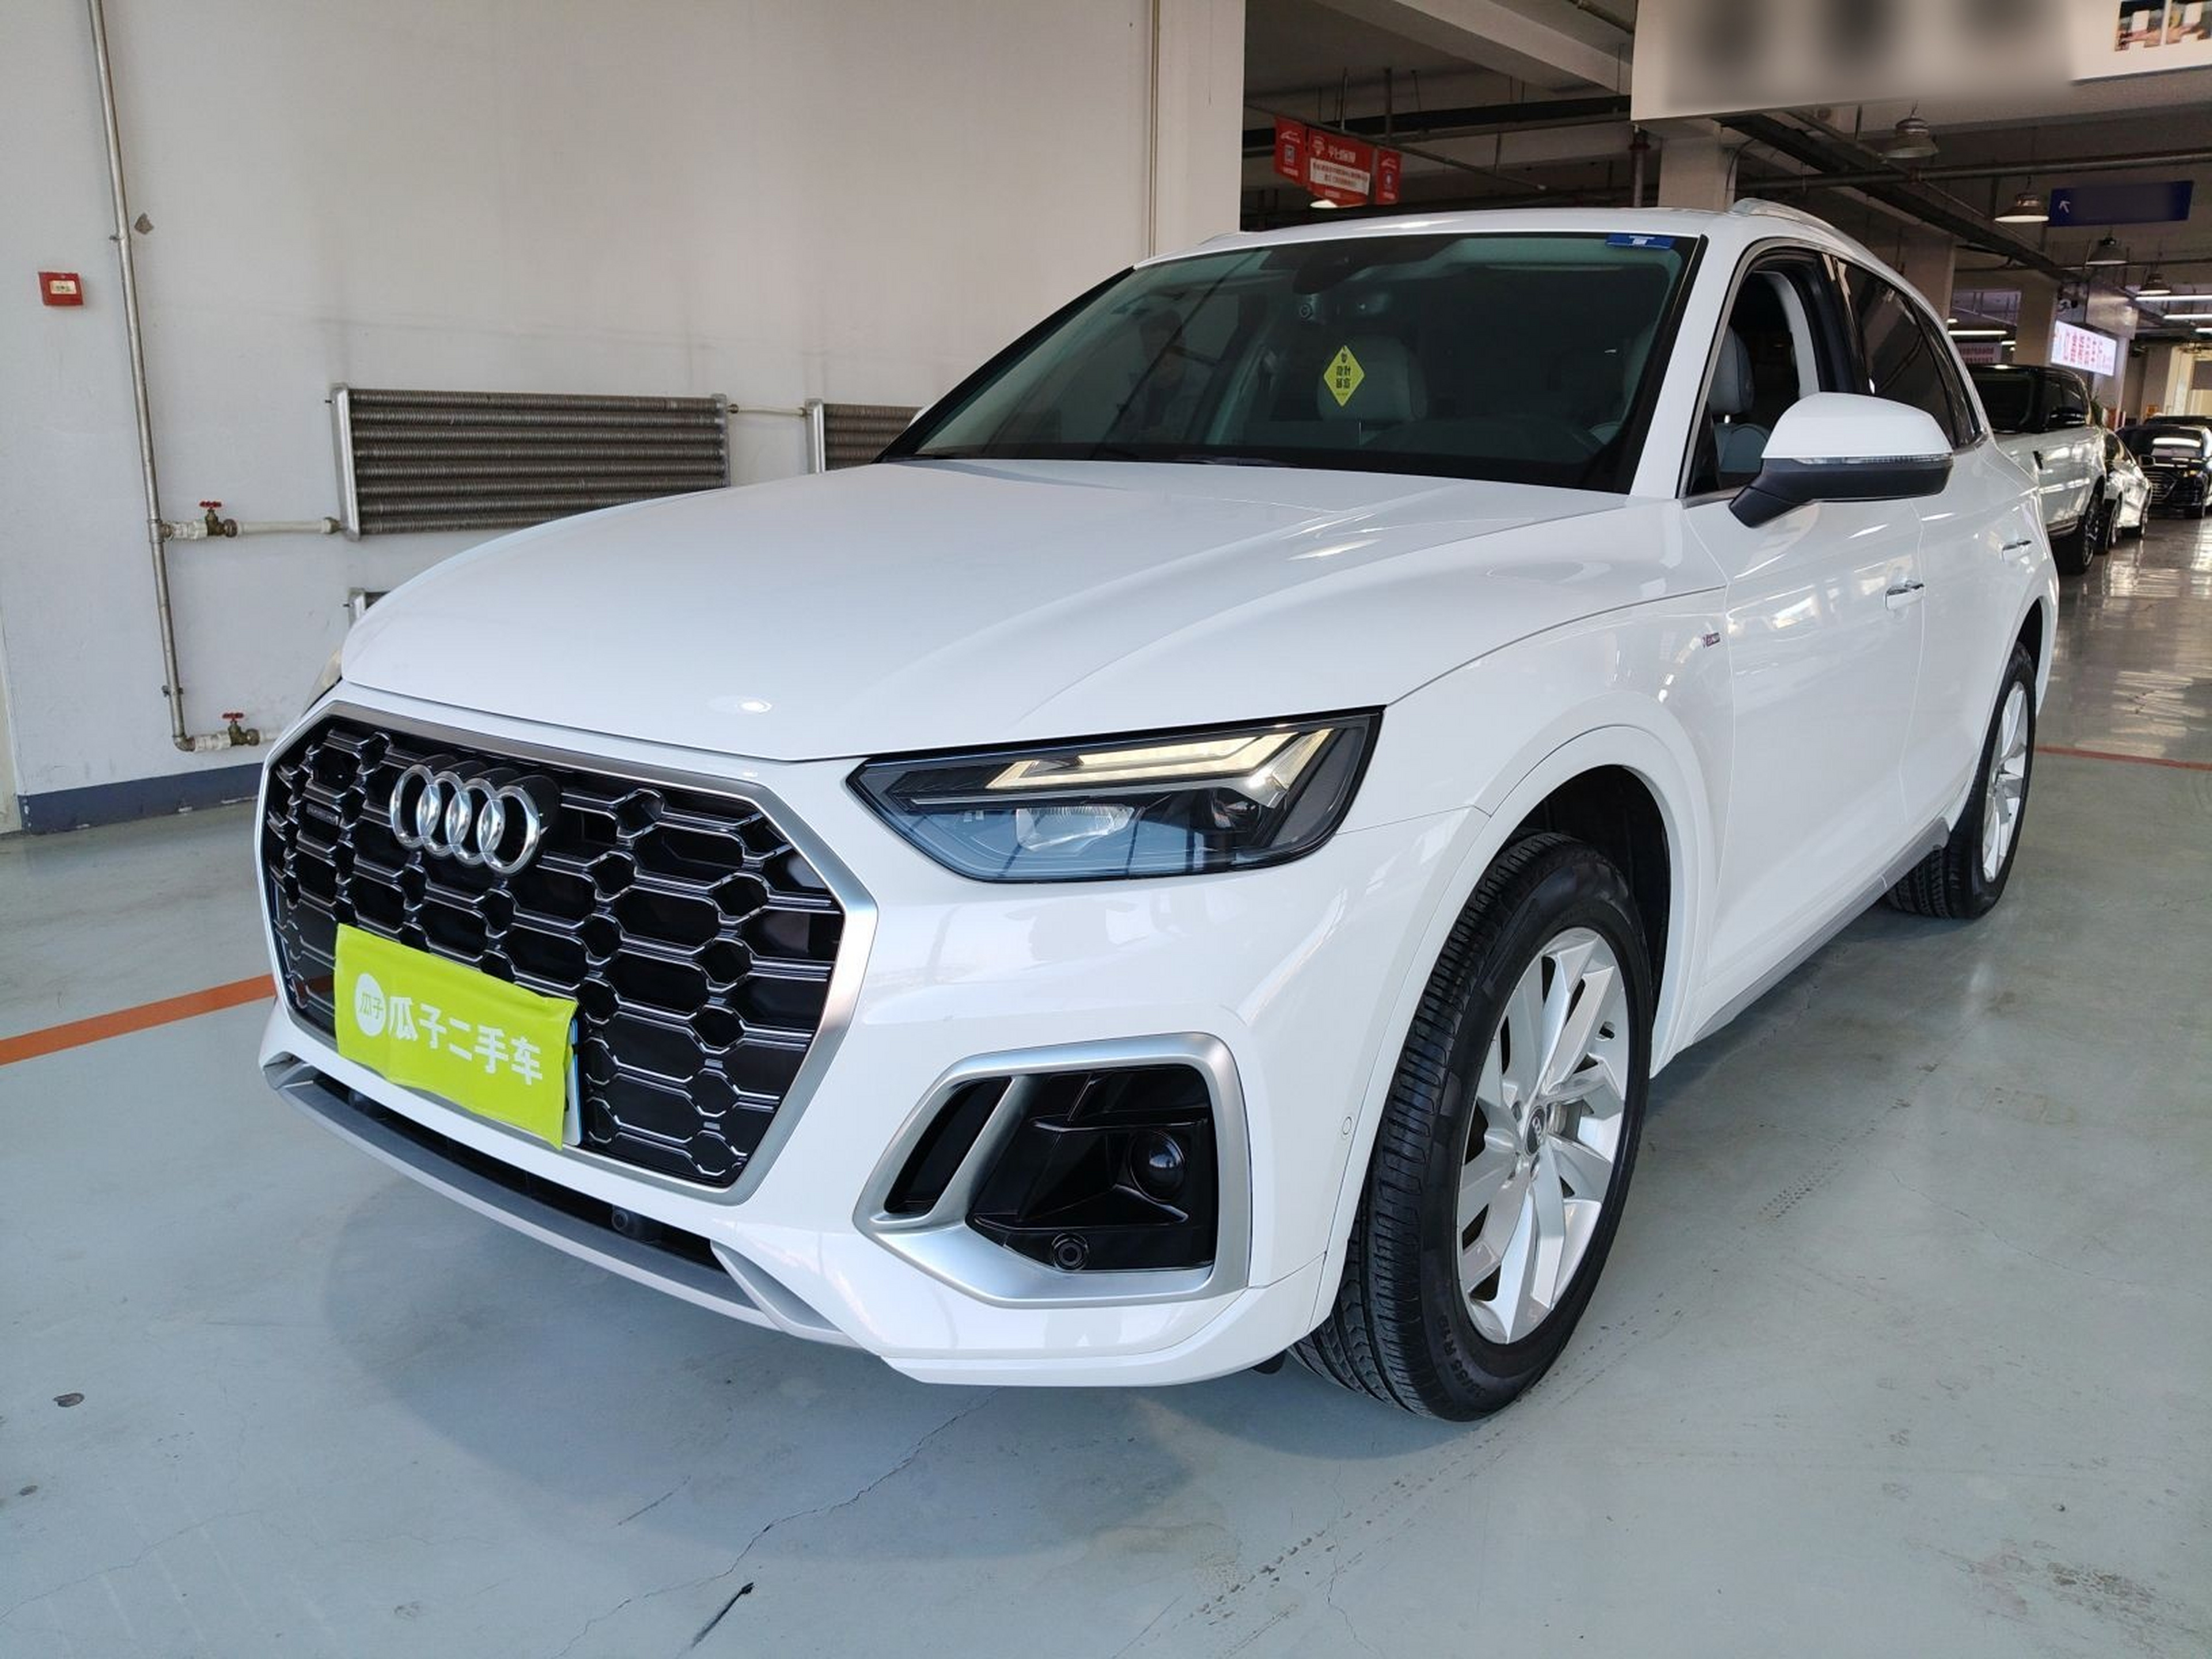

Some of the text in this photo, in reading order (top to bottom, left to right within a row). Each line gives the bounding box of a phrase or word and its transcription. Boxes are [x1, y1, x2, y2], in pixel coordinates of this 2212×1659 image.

[359, 993, 543, 1086] 瓜子 瓜子二手车
